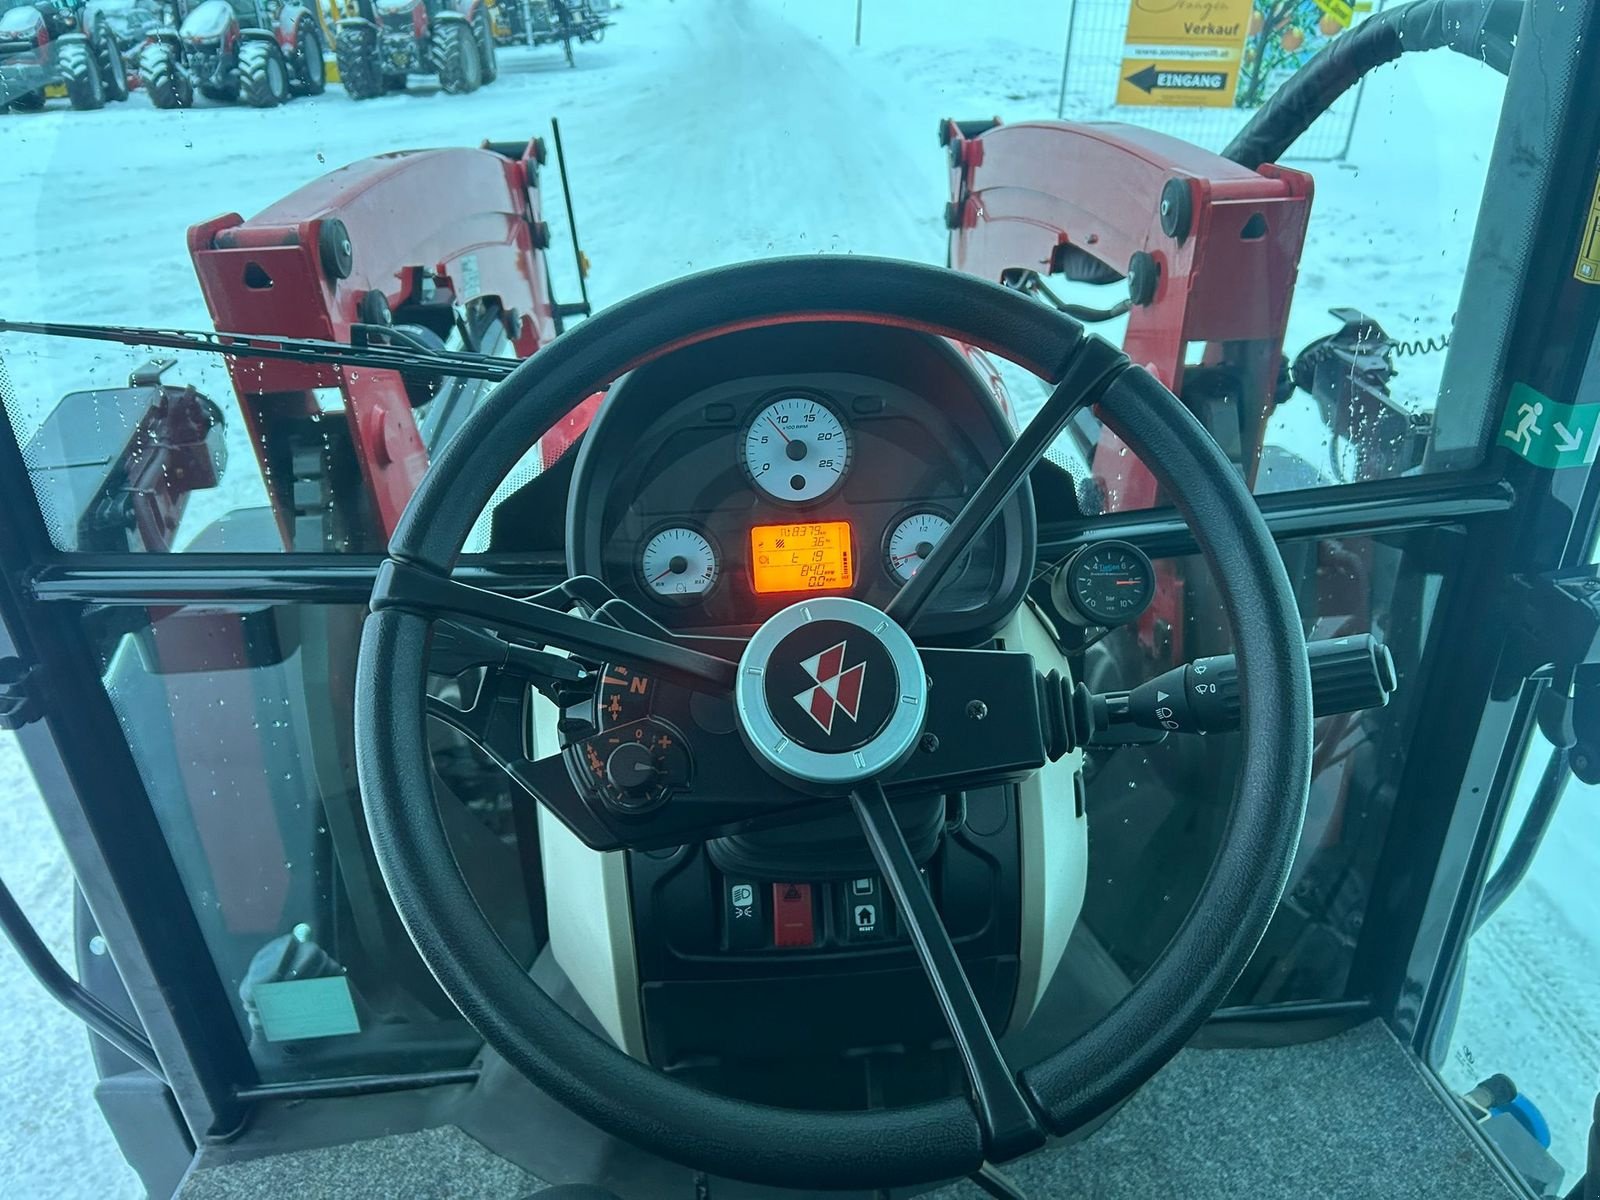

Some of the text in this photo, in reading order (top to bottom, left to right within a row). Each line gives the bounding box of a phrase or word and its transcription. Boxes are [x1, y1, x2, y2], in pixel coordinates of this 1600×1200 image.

[1184, 22, 1239, 35] Verkauf
[1156, 73, 1222, 88] EINGANG
[776, 415, 789, 424] 10
[803, 414, 816, 422] 15
[761, 436, 769, 444] 5
[817, 432, 832, 441] 20
[762, 463, 770, 471] 0
[818, 460, 834, 468] 25
[801, 564, 825, 576] 840
[1120, 600, 1128, 608] 10
[630, 676, 648, 694] N
[635, 729, 643, 738] 0
